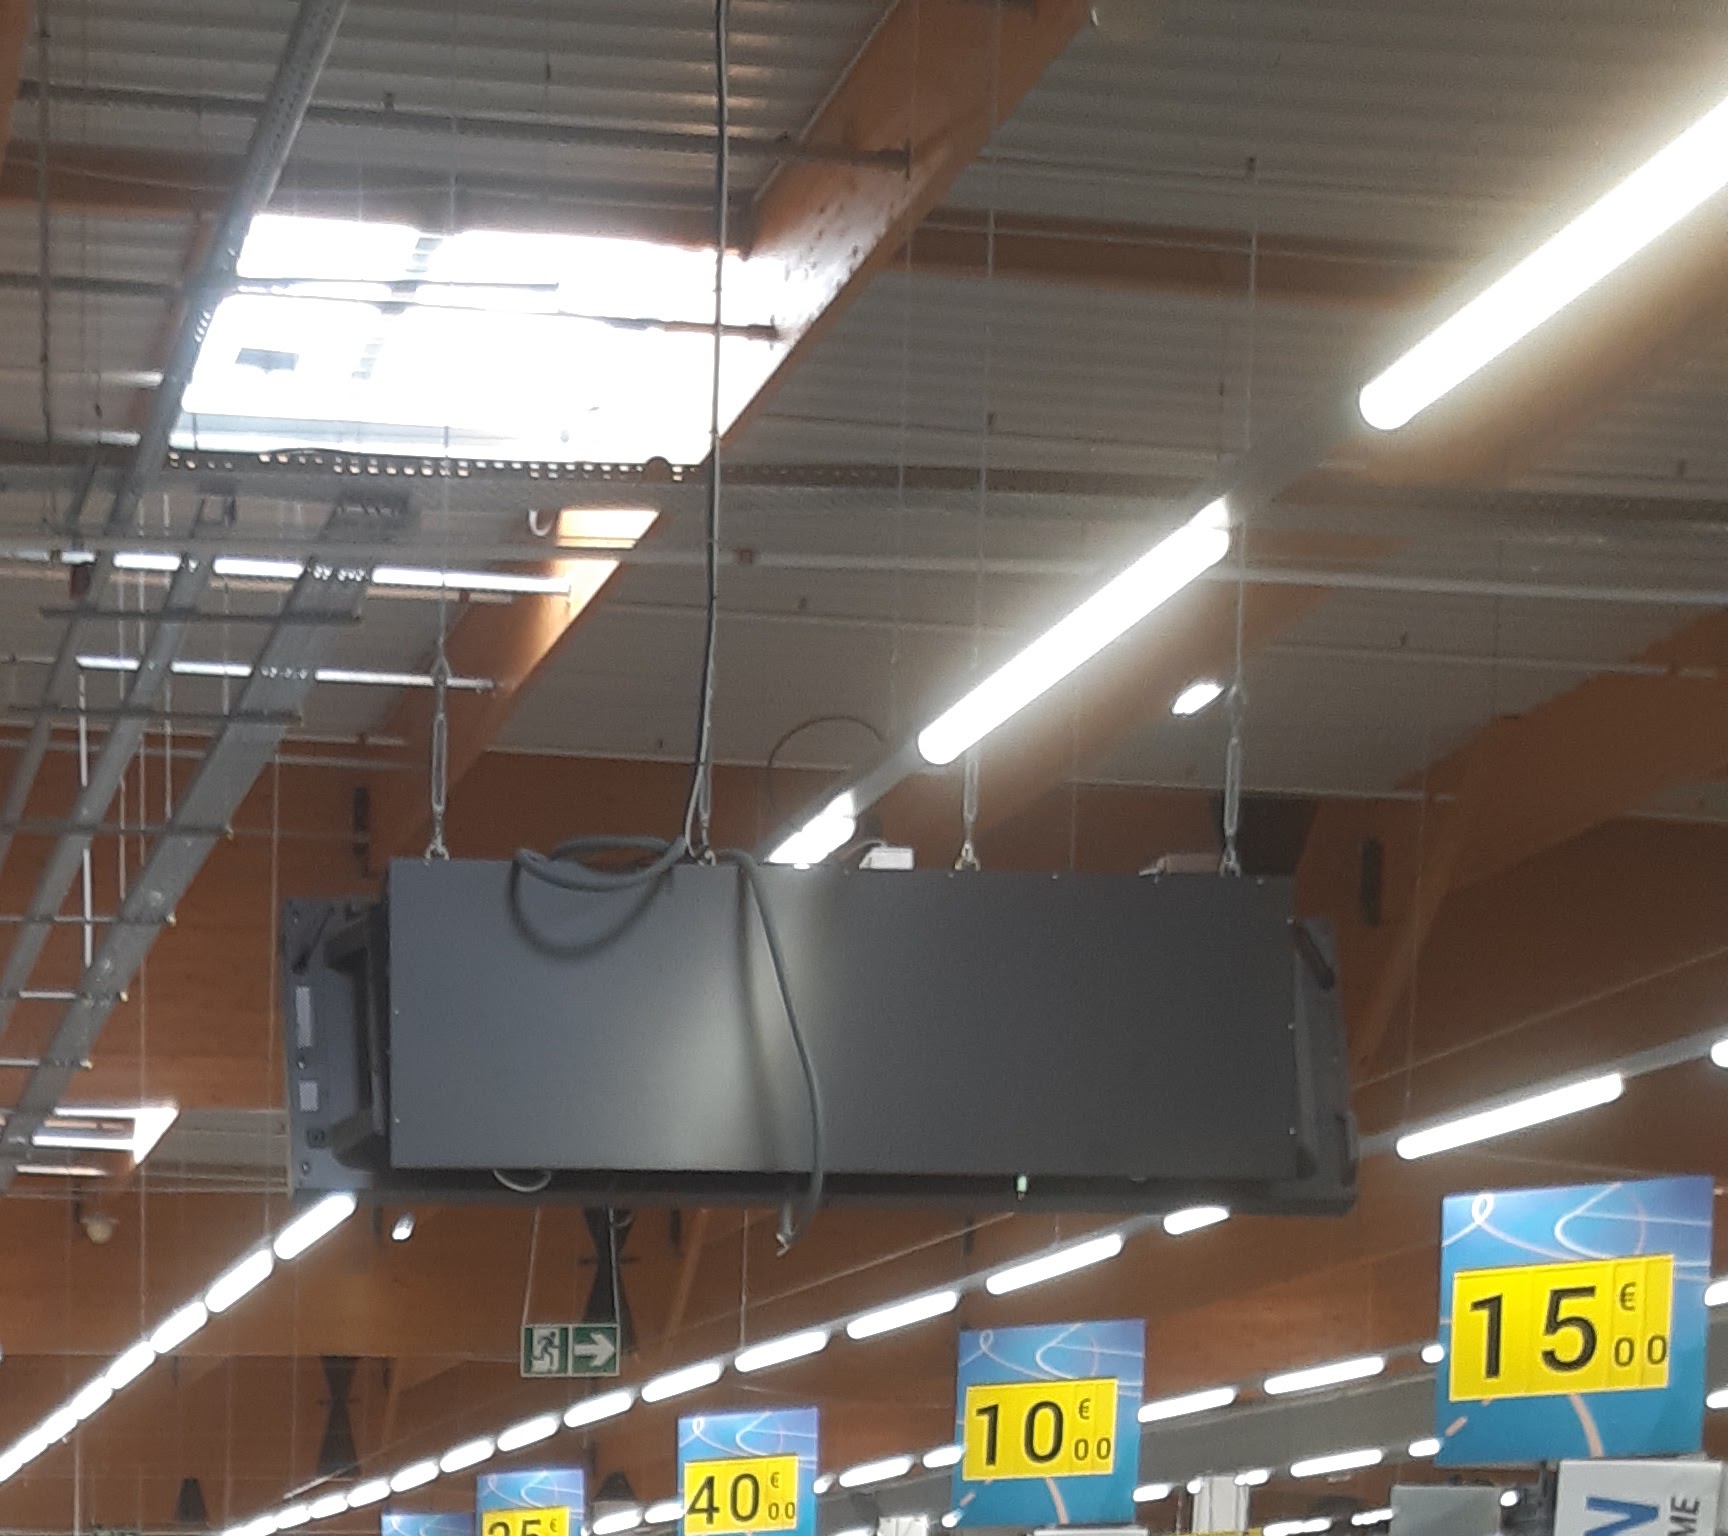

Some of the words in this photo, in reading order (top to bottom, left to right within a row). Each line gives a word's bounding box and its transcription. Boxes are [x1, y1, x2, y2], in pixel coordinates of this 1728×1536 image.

[1469, 1286, 1597, 1380] 15
[975, 1400, 1065, 1467] 10
[687, 1473, 760, 1525] 40
